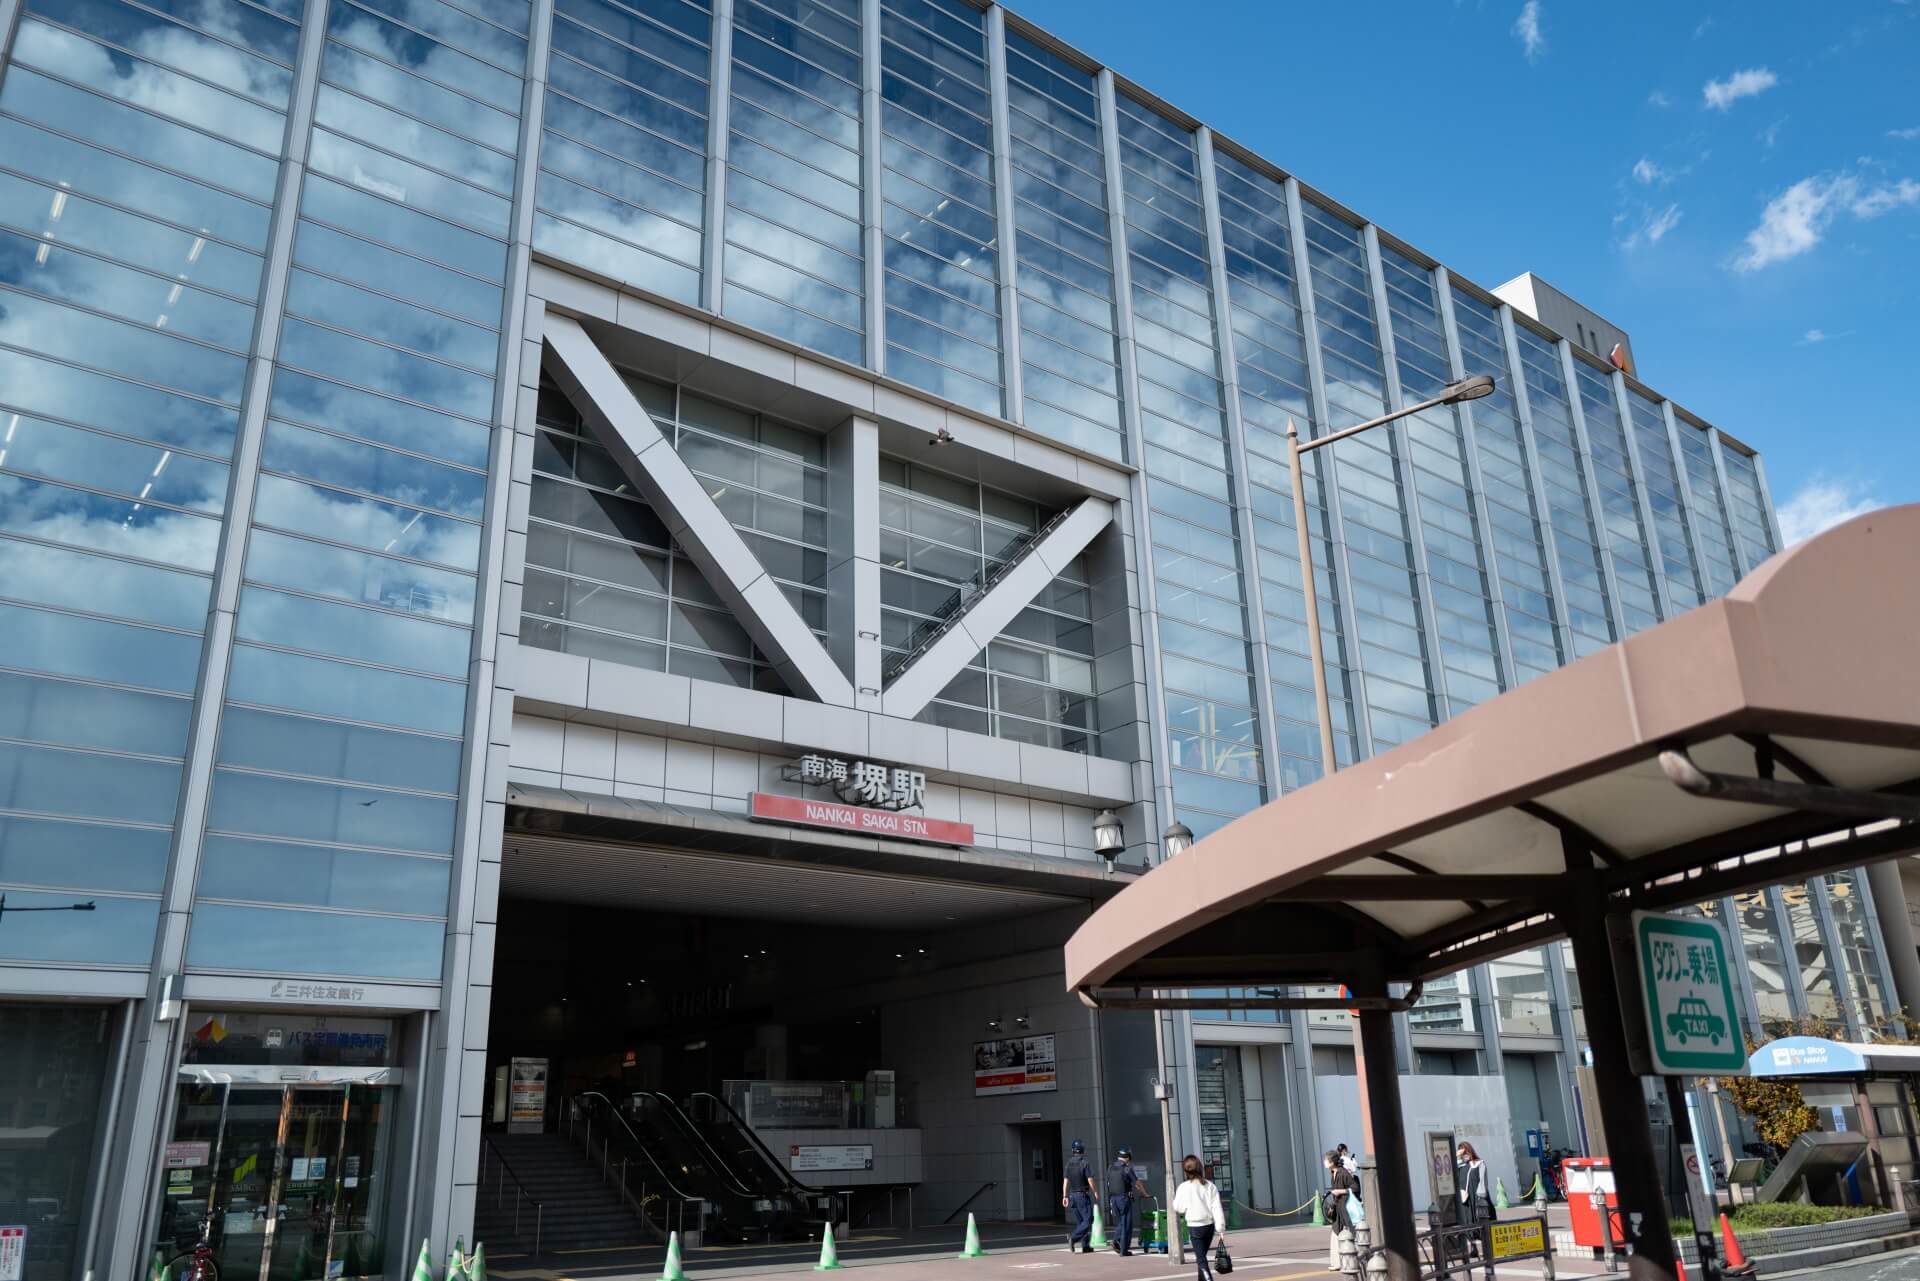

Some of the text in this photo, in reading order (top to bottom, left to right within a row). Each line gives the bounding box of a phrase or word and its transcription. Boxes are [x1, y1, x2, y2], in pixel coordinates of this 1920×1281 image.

[800, 754, 926, 810] 南海 堺駅
[806, 804, 929, 835] NANKAI SAKAI STN.
[1653, 940, 1719, 985] タクシー乗場
[286, 984, 364, 1001] 三井住友銀行
[1684, 1018, 1709, 1034] TAXI
[1790, 1047, 1805, 1056] Bus
